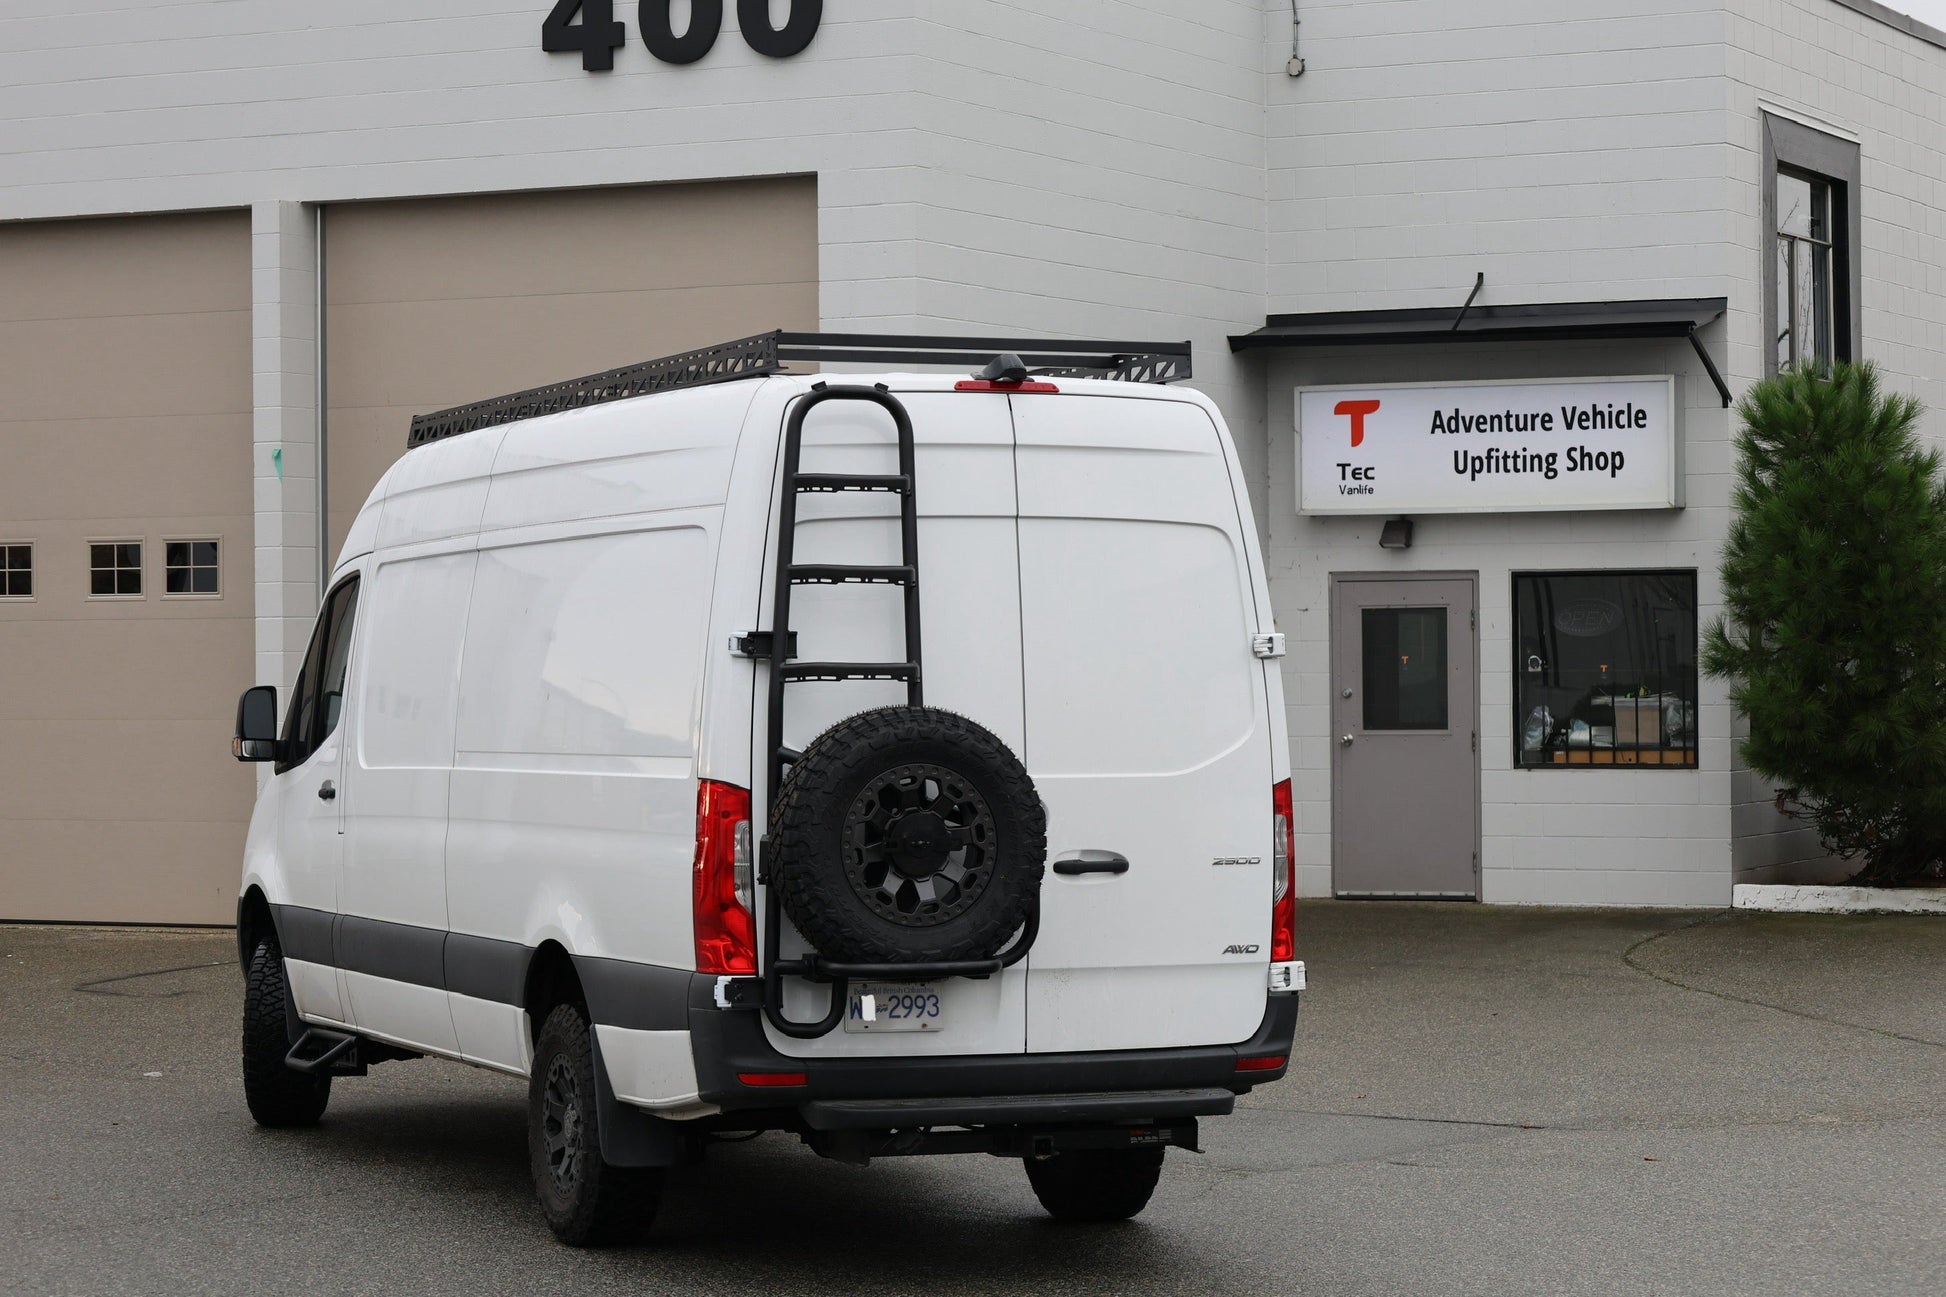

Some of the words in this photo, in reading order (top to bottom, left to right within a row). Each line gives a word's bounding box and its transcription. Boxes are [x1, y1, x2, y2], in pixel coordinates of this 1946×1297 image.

[1334, 399, 1380, 448] T
[1430, 407, 1554, 435] Adventure
[1561, 402, 1648, 431] Vehicle
[1453, 446, 1559, 482] Upfitting
[1566, 445, 1625, 479] Shop
[1338, 483, 1375, 496] Vanlife
[1211, 856, 1261, 866] 2500
[1222, 944, 1260, 955] AWD
[888, 994, 939, 1018] 2993
